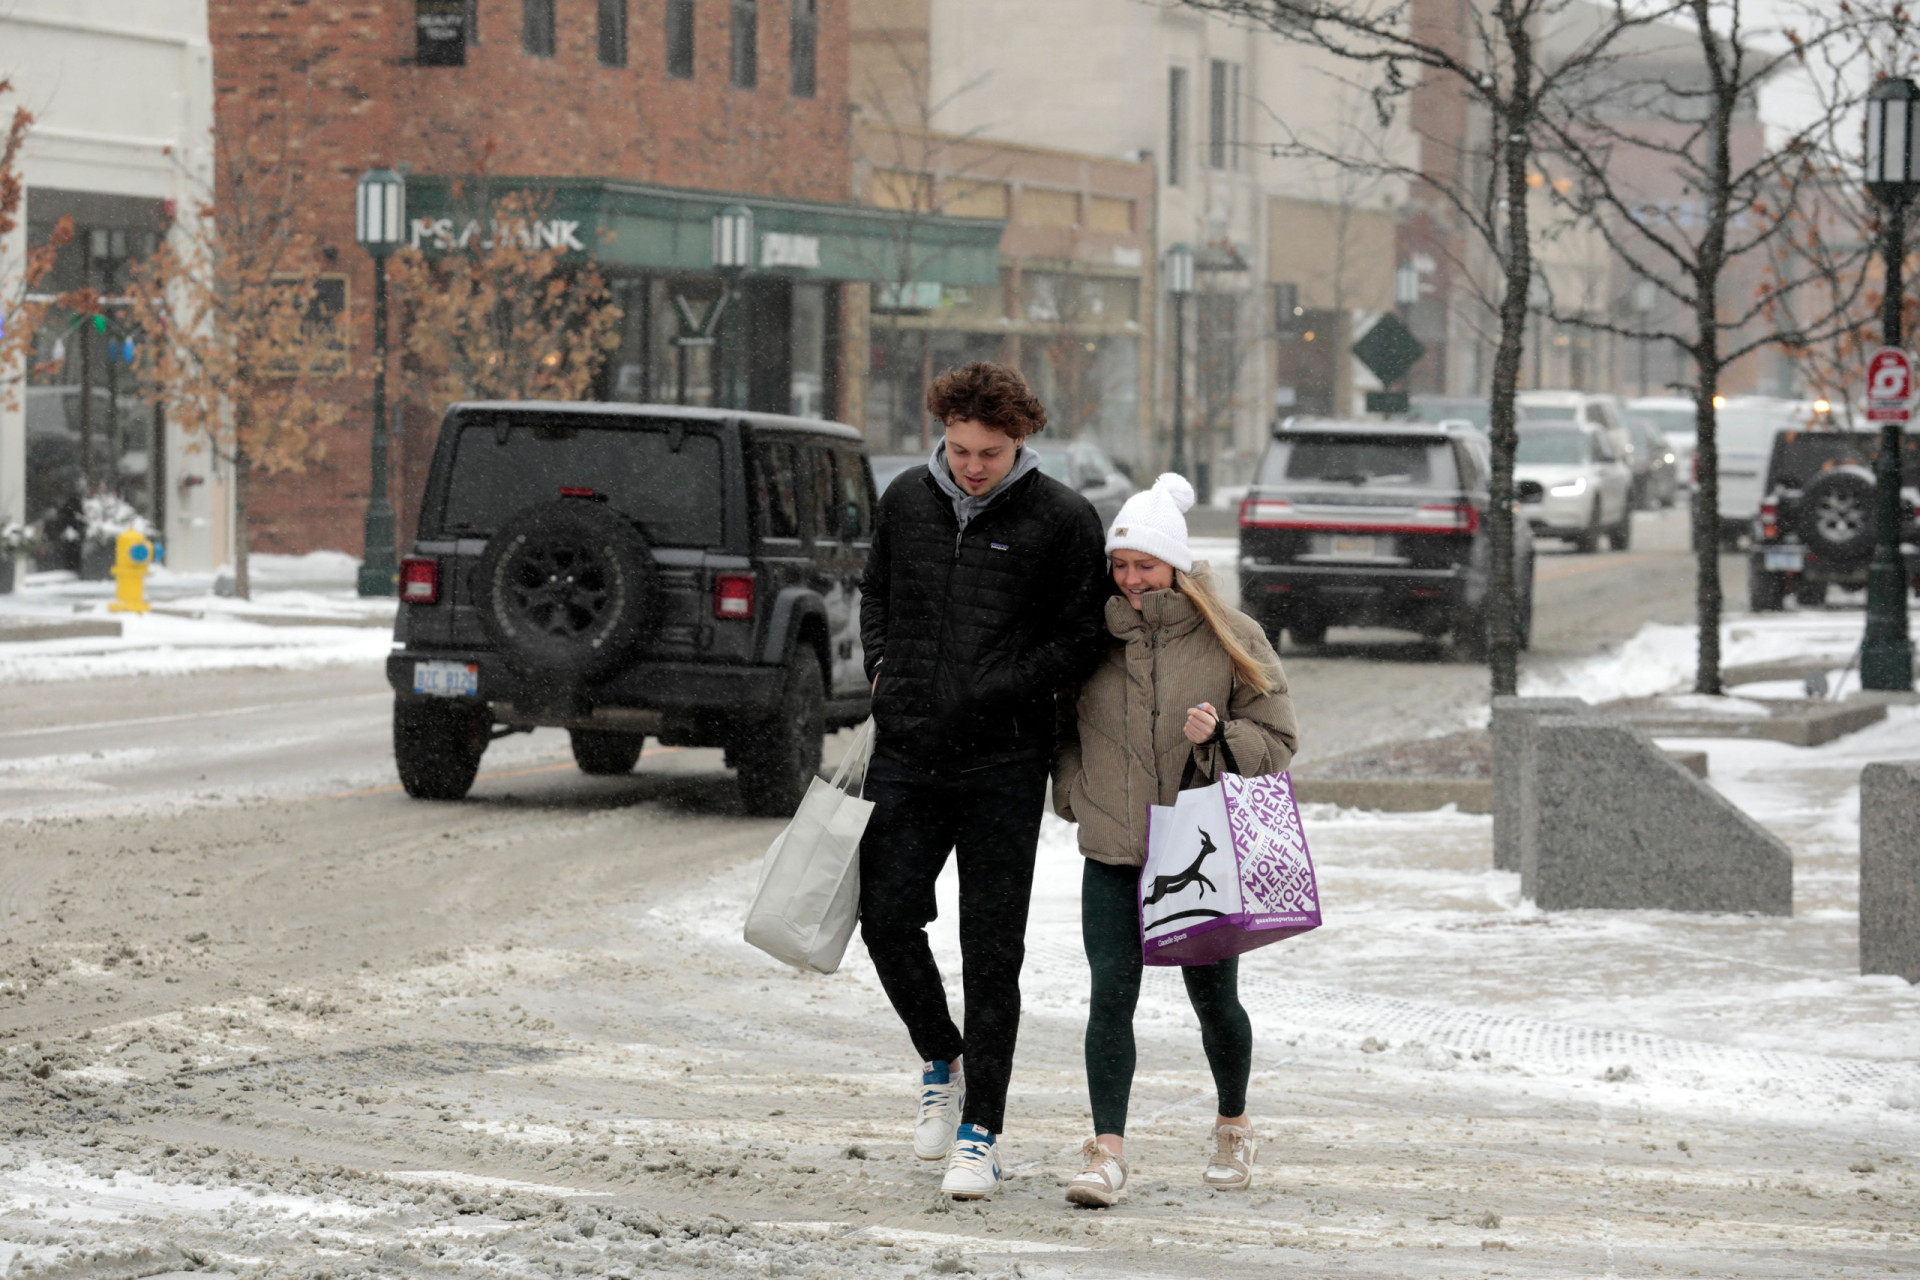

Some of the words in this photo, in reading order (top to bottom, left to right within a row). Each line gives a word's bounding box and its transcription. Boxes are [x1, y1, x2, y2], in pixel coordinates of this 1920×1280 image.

[1241, 868, 1251, 881] WE
[1250, 834, 1270, 867] BELIEVE
[1245, 839, 1284, 893] MOVE
[1254, 847, 1294, 904] MENT
[1269, 858, 1302, 903] CHANGE
[1275, 867, 1311, 911] YOUR
